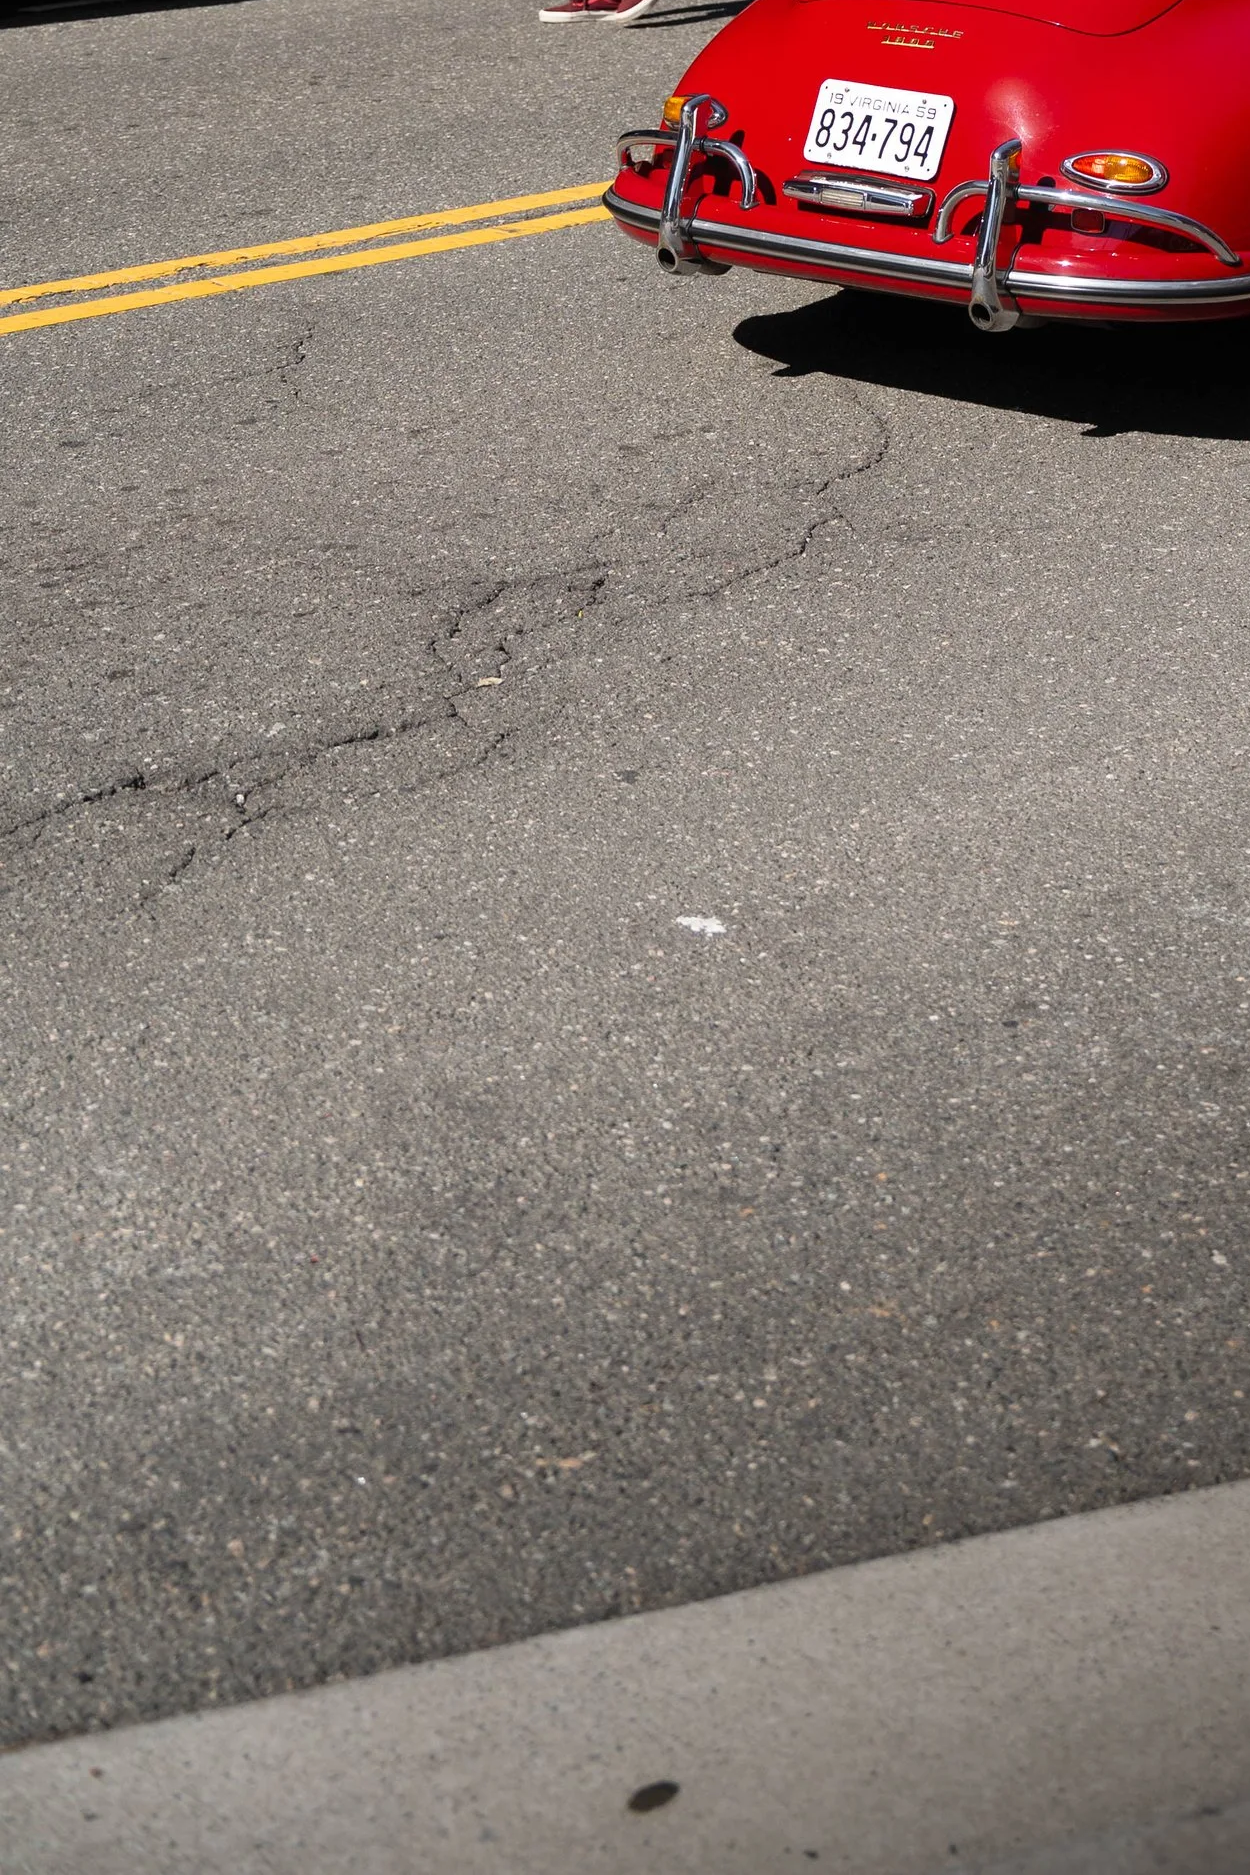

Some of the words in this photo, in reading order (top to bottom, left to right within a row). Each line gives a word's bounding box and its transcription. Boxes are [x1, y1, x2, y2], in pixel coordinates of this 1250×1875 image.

[829, 92, 844, 105] 19
[850, 95, 910, 115] VIRGINIA
[916, 105, 937, 121] 59
